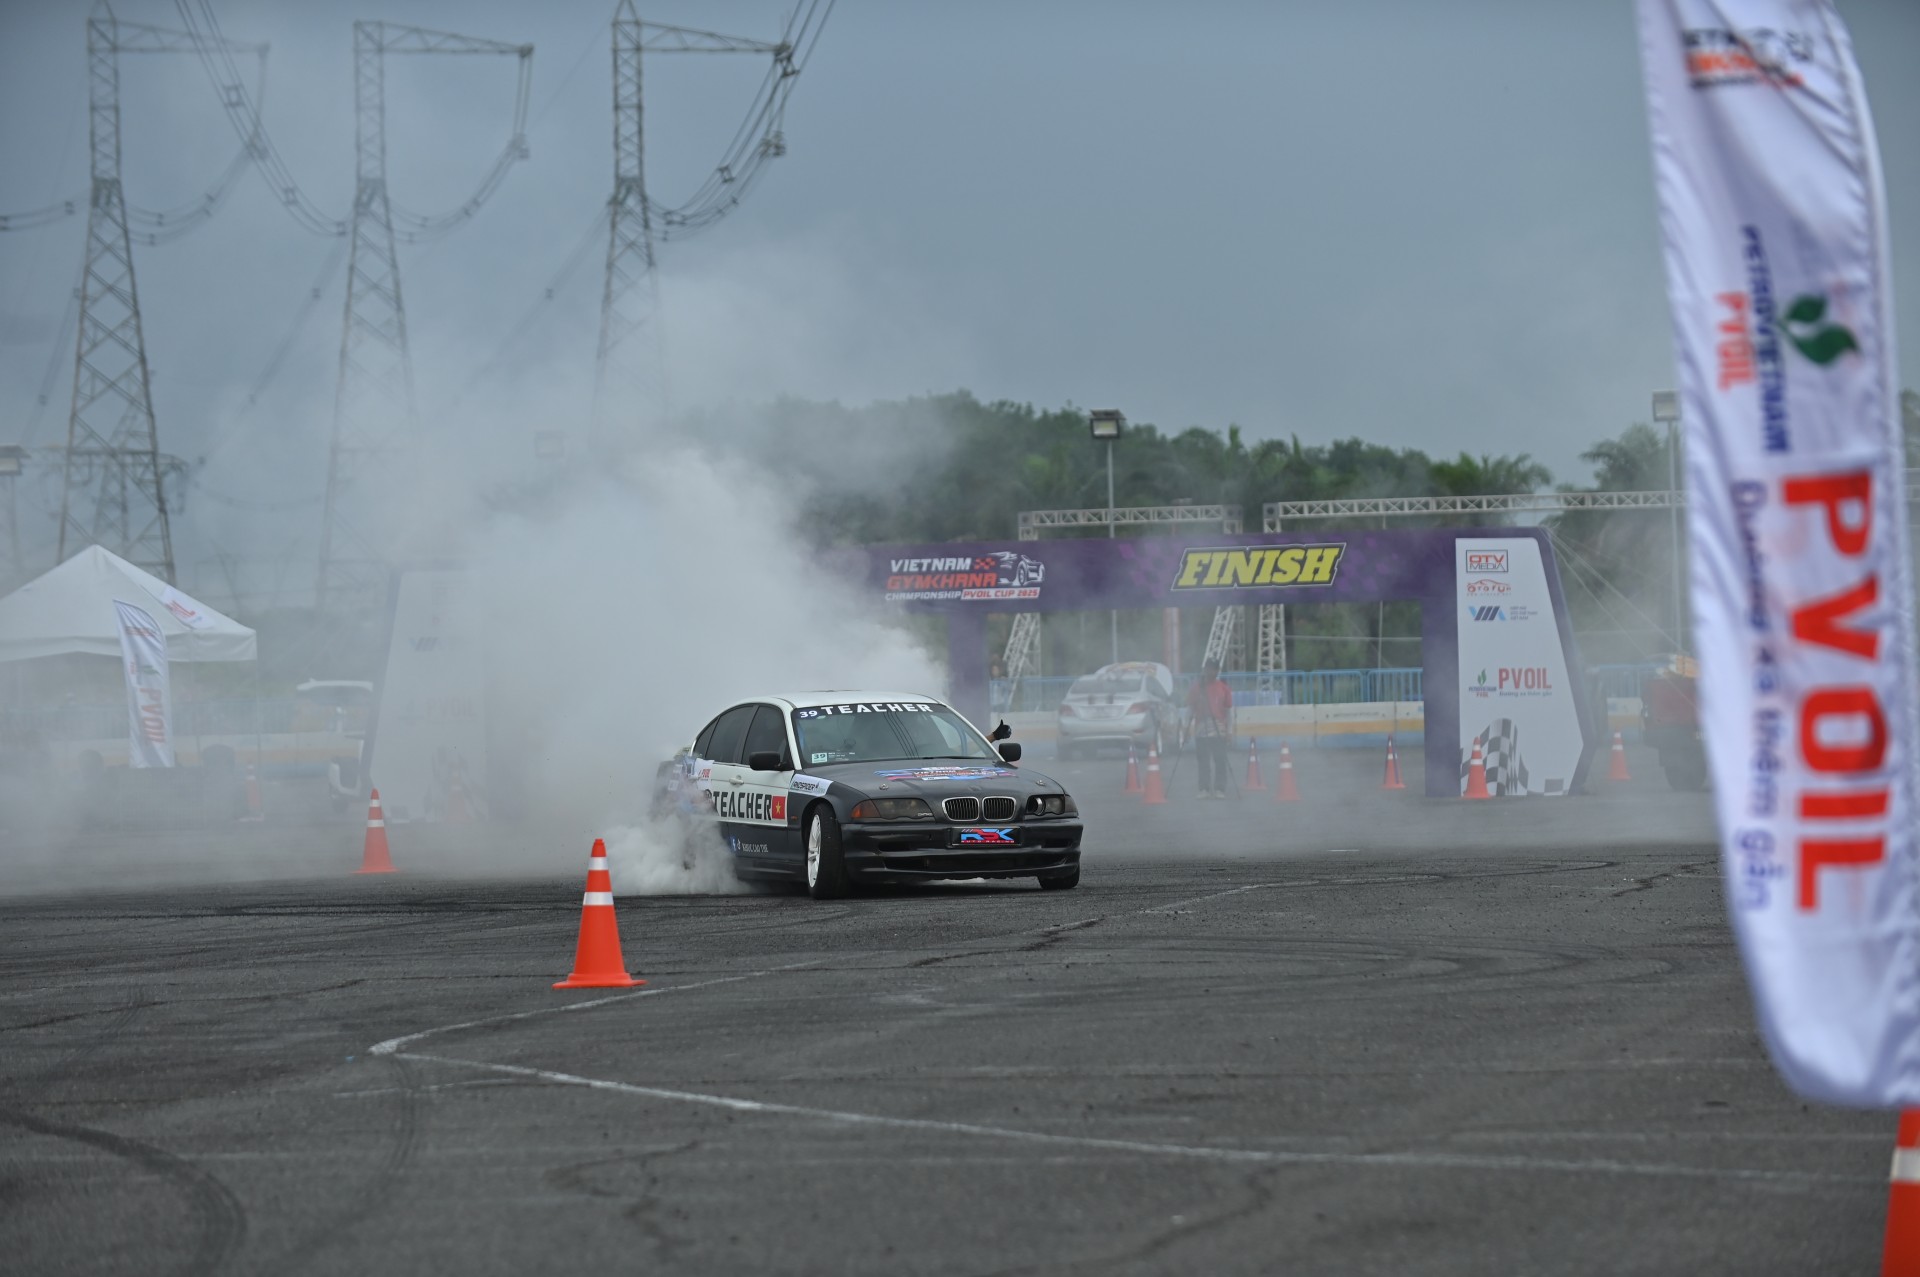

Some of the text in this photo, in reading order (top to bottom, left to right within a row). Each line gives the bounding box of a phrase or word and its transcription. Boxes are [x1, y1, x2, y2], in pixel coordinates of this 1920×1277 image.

[1715, 291, 1757, 391] PVOIL
[890, 557, 972, 572] VIETNAM
[1178, 546, 1338, 587] FINISH
[1469, 554, 1505, 563] OTV
[1469, 563, 1506, 572] MEDIA
[886, 572, 998, 590] GYMKHANA
[885, 588, 1038, 601] CHAMPIONSHIP PVOIL CUP 2025
[1498, 667, 1552, 690] PVOIL
[1781, 470, 1890, 911] PVOIL
[799, 703, 934, 718] 39 TEACHER
[712, 791, 772, 821] TEACHER
[960, 828, 1014, 841] RSK
